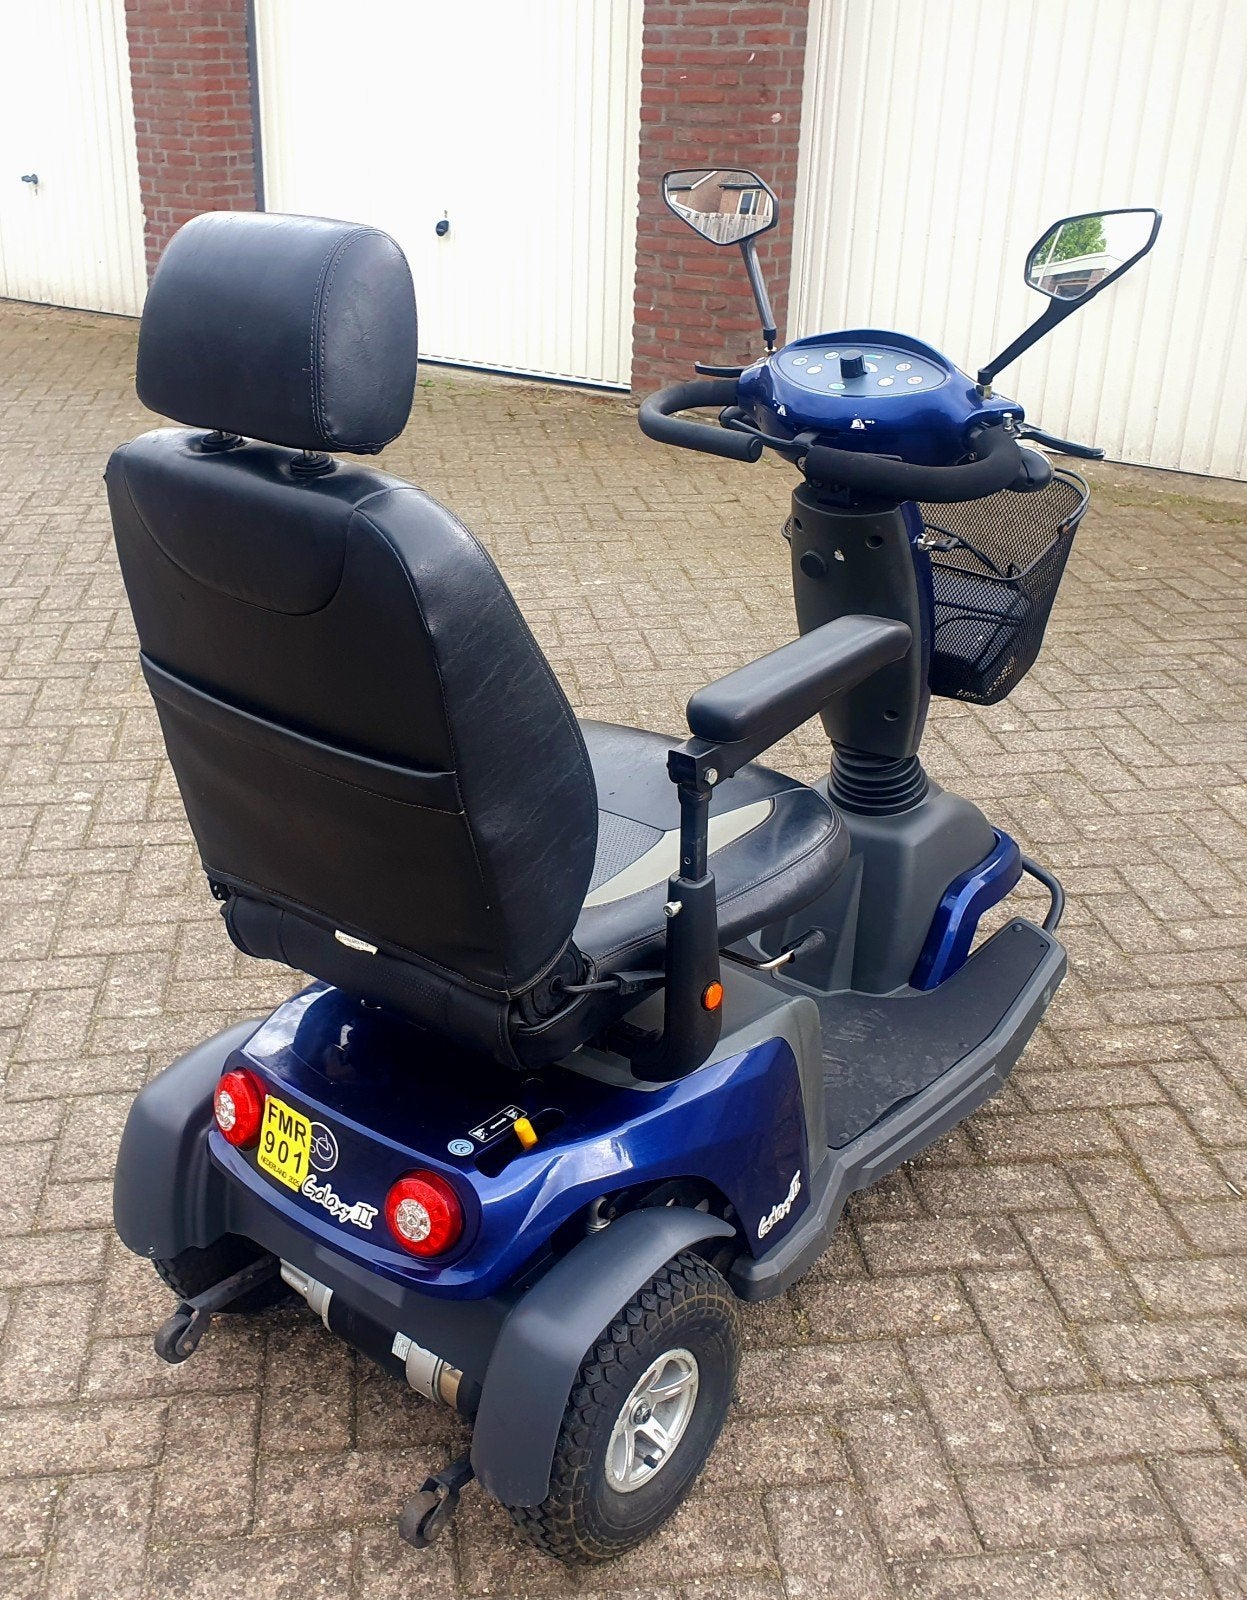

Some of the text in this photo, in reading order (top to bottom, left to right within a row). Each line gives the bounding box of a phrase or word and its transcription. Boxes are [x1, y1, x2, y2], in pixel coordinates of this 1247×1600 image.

[268, 1102, 307, 1148] FMR
[260, 1154, 287, 1179] NEDERLAND
[264, 1130, 302, 1174] 901
[302, 1175, 377, 1228] Galaxy II
